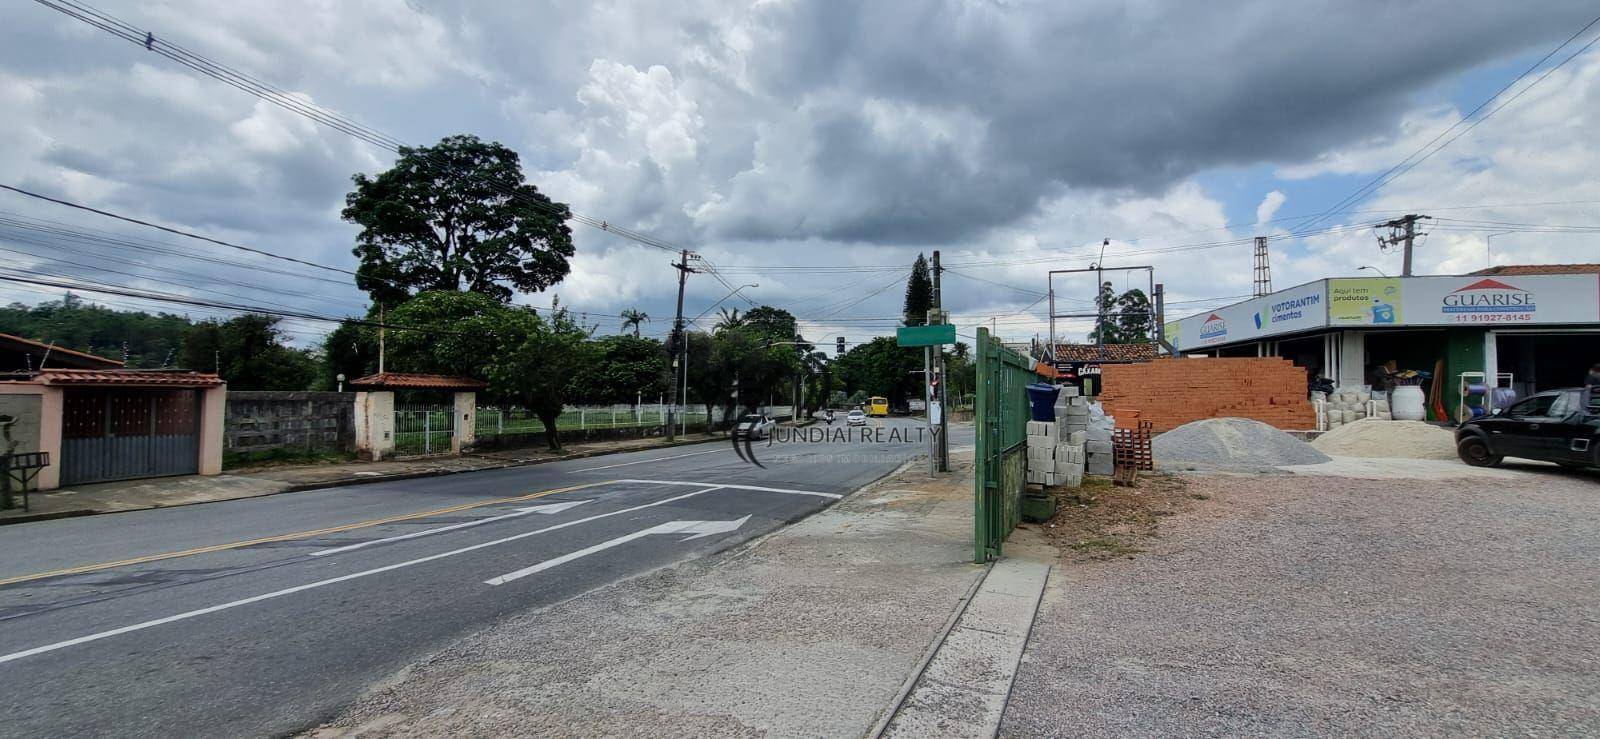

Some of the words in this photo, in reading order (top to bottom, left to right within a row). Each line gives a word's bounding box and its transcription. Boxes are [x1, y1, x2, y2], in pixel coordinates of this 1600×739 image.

[1271, 294, 1320, 313] VOTORANTIM
[1333, 294, 1369, 302] produtos
[1443, 293, 1536, 306] GUARISE
[1271, 311, 1303, 323] cimentos
